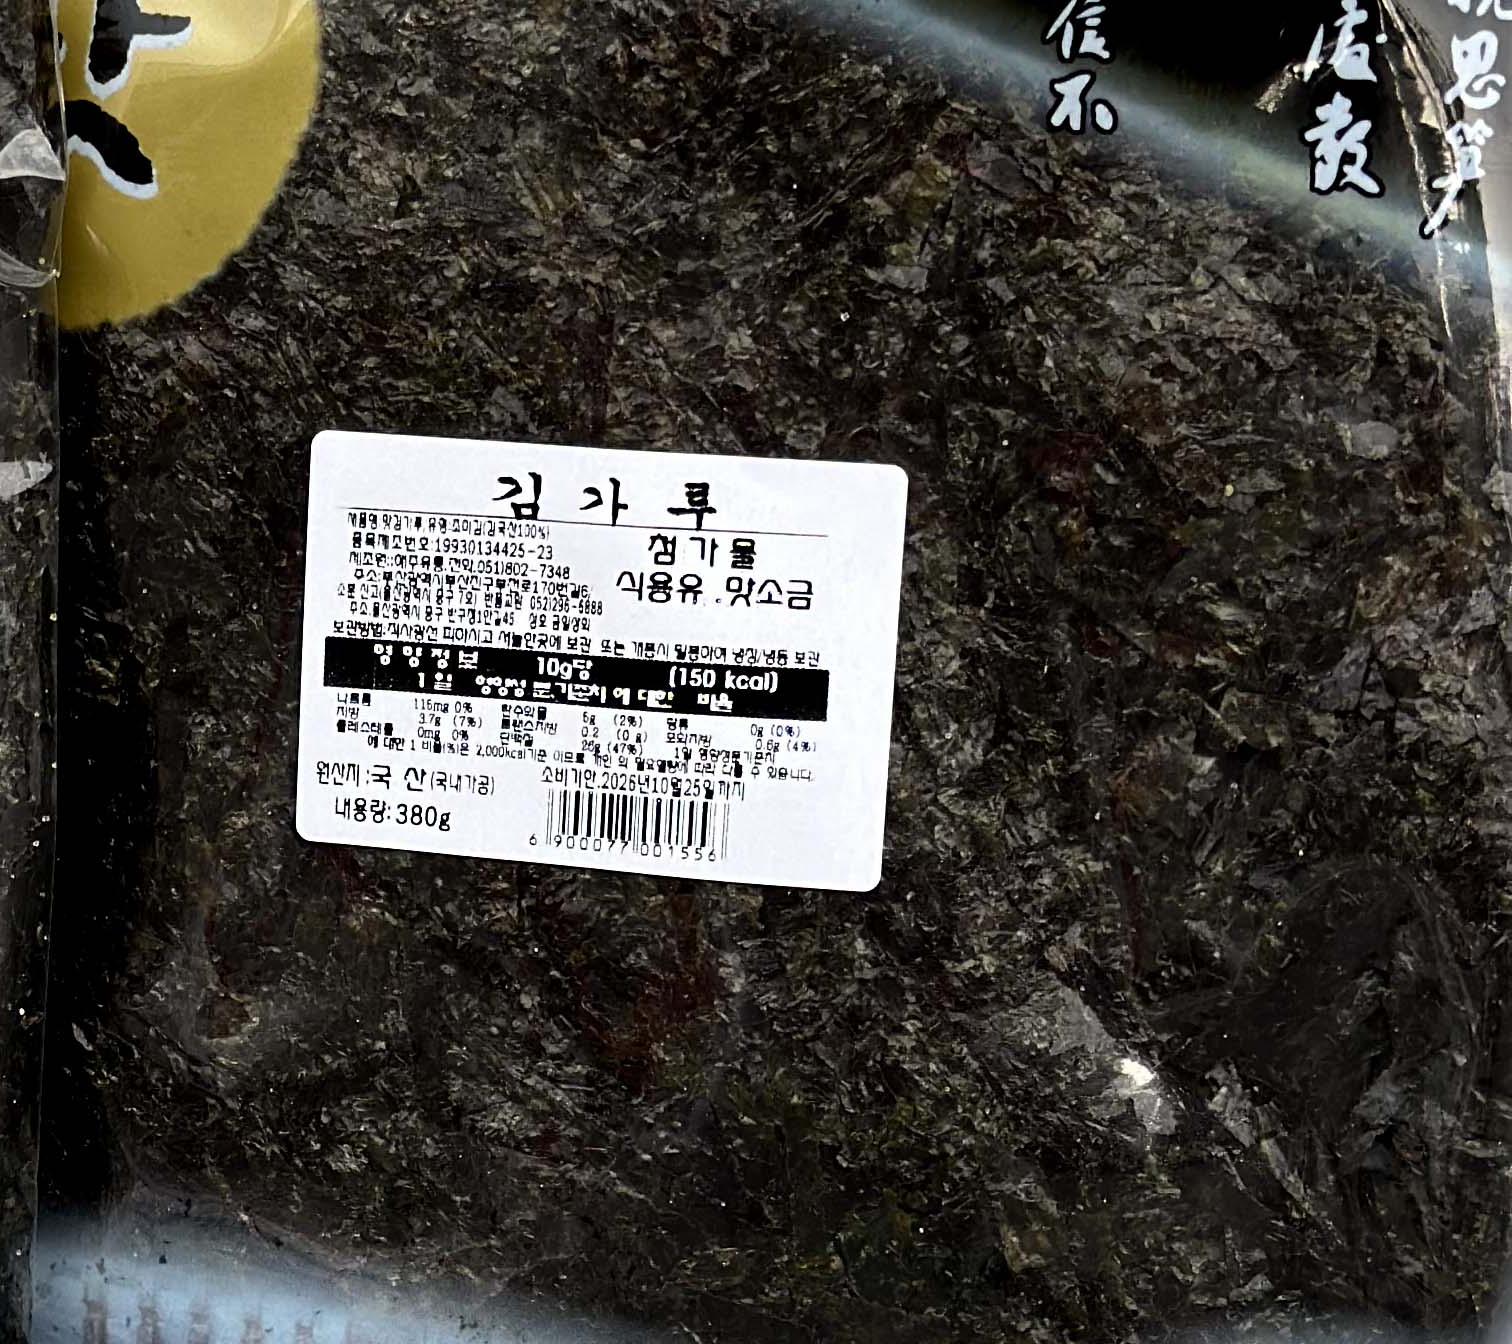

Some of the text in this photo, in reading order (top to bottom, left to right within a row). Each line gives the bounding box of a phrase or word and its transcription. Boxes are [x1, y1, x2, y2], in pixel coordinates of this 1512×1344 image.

[669, 666, 715, 687] (150
[724, 670, 777, 693] kcal)
[335, 797, 450, 831] 내용량:380g
